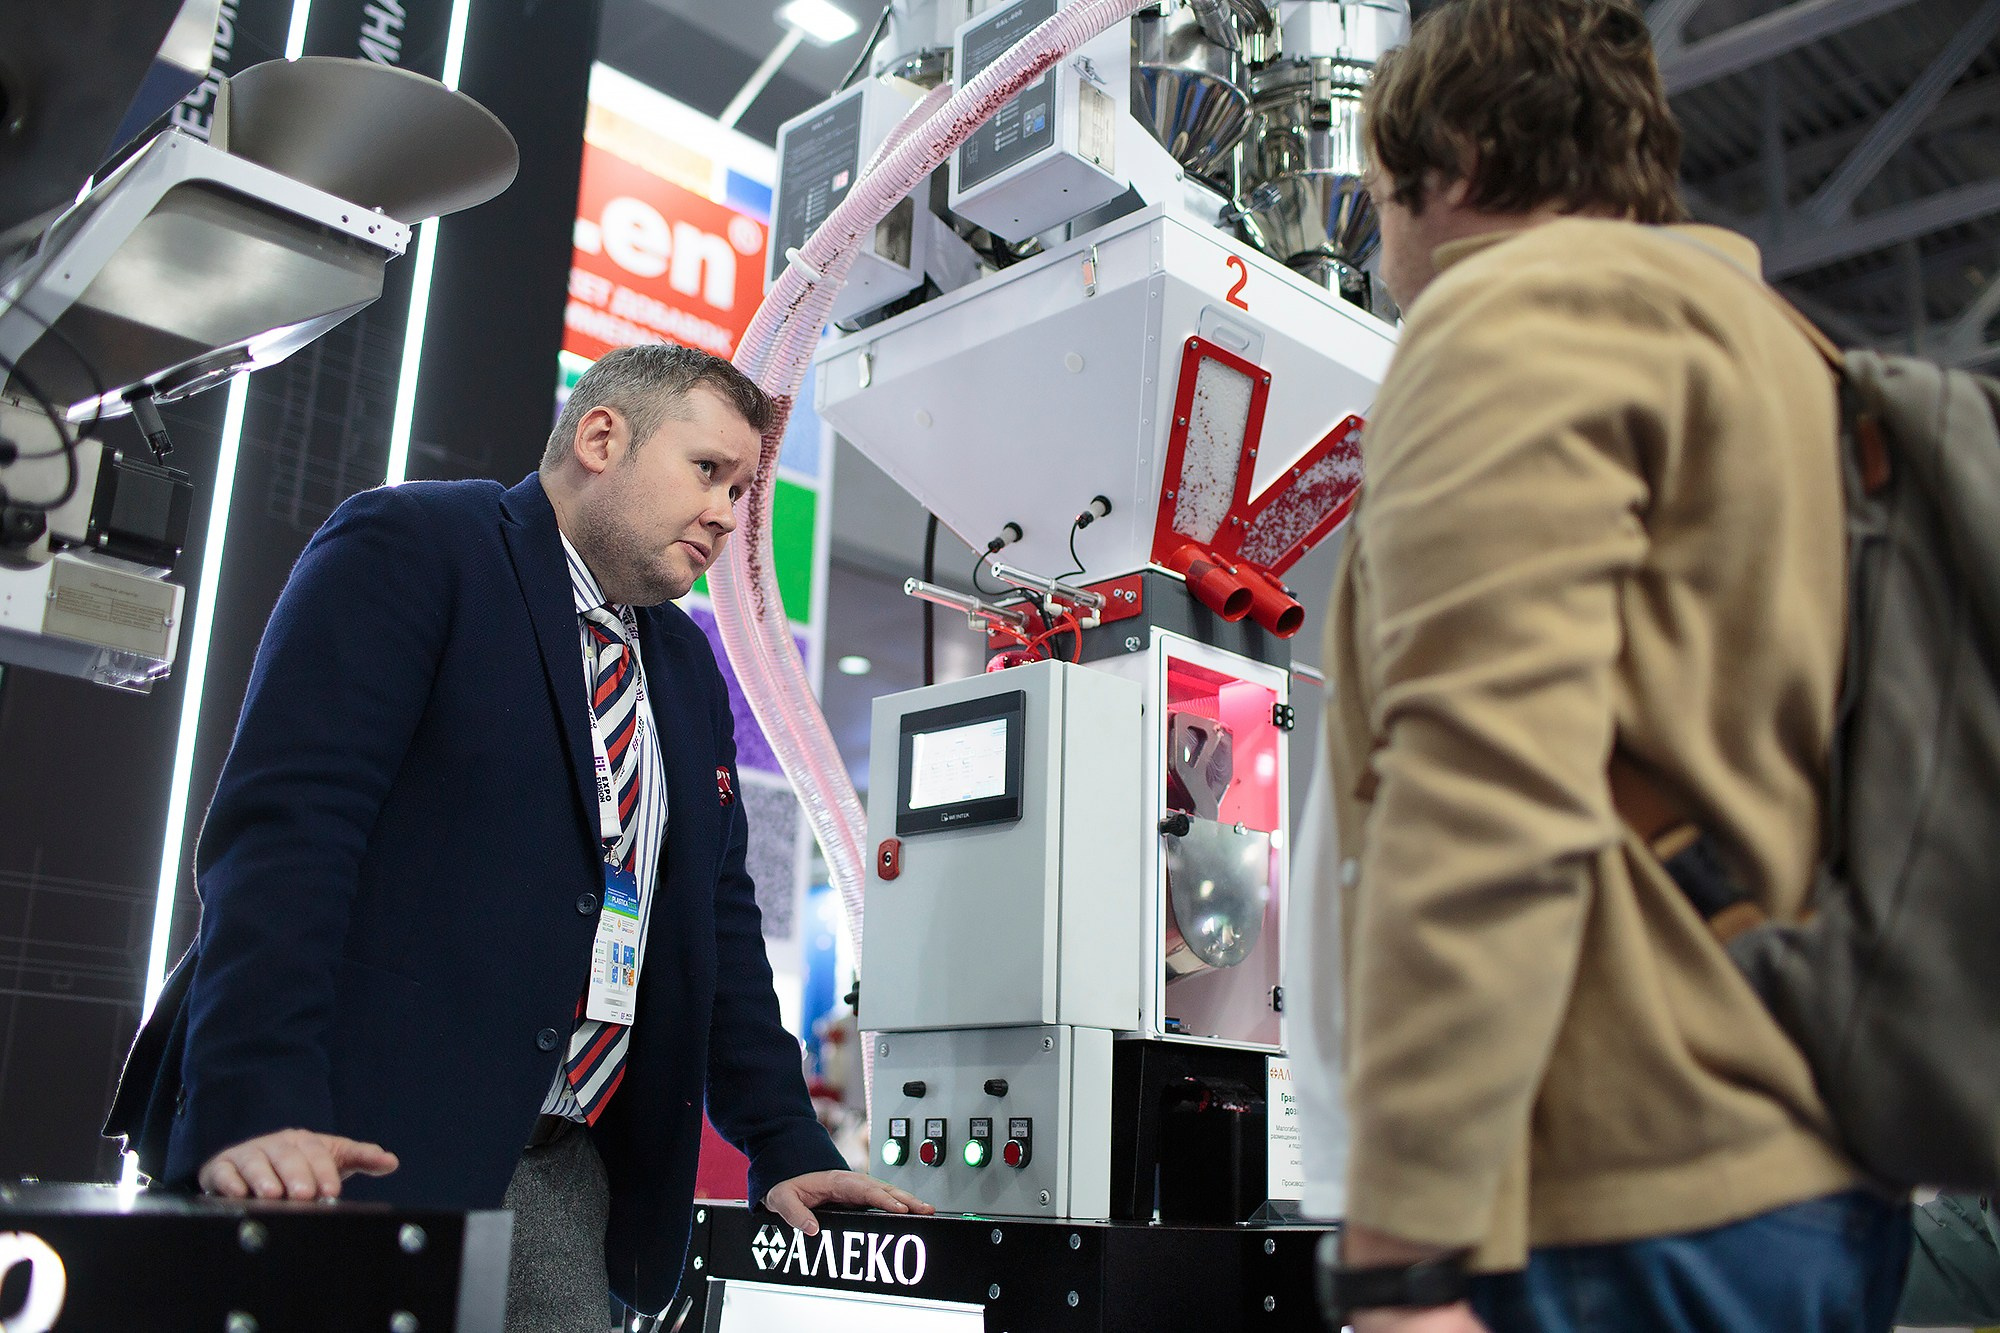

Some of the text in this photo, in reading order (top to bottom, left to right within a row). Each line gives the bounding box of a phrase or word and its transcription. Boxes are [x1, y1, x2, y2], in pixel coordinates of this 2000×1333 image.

[1226, 255, 1248, 312] 2
[601, 775, 612, 802] EXPO
[1285, 1107, 1298, 1117] доз
[782, 1226, 927, 1286] АЛЕКО
